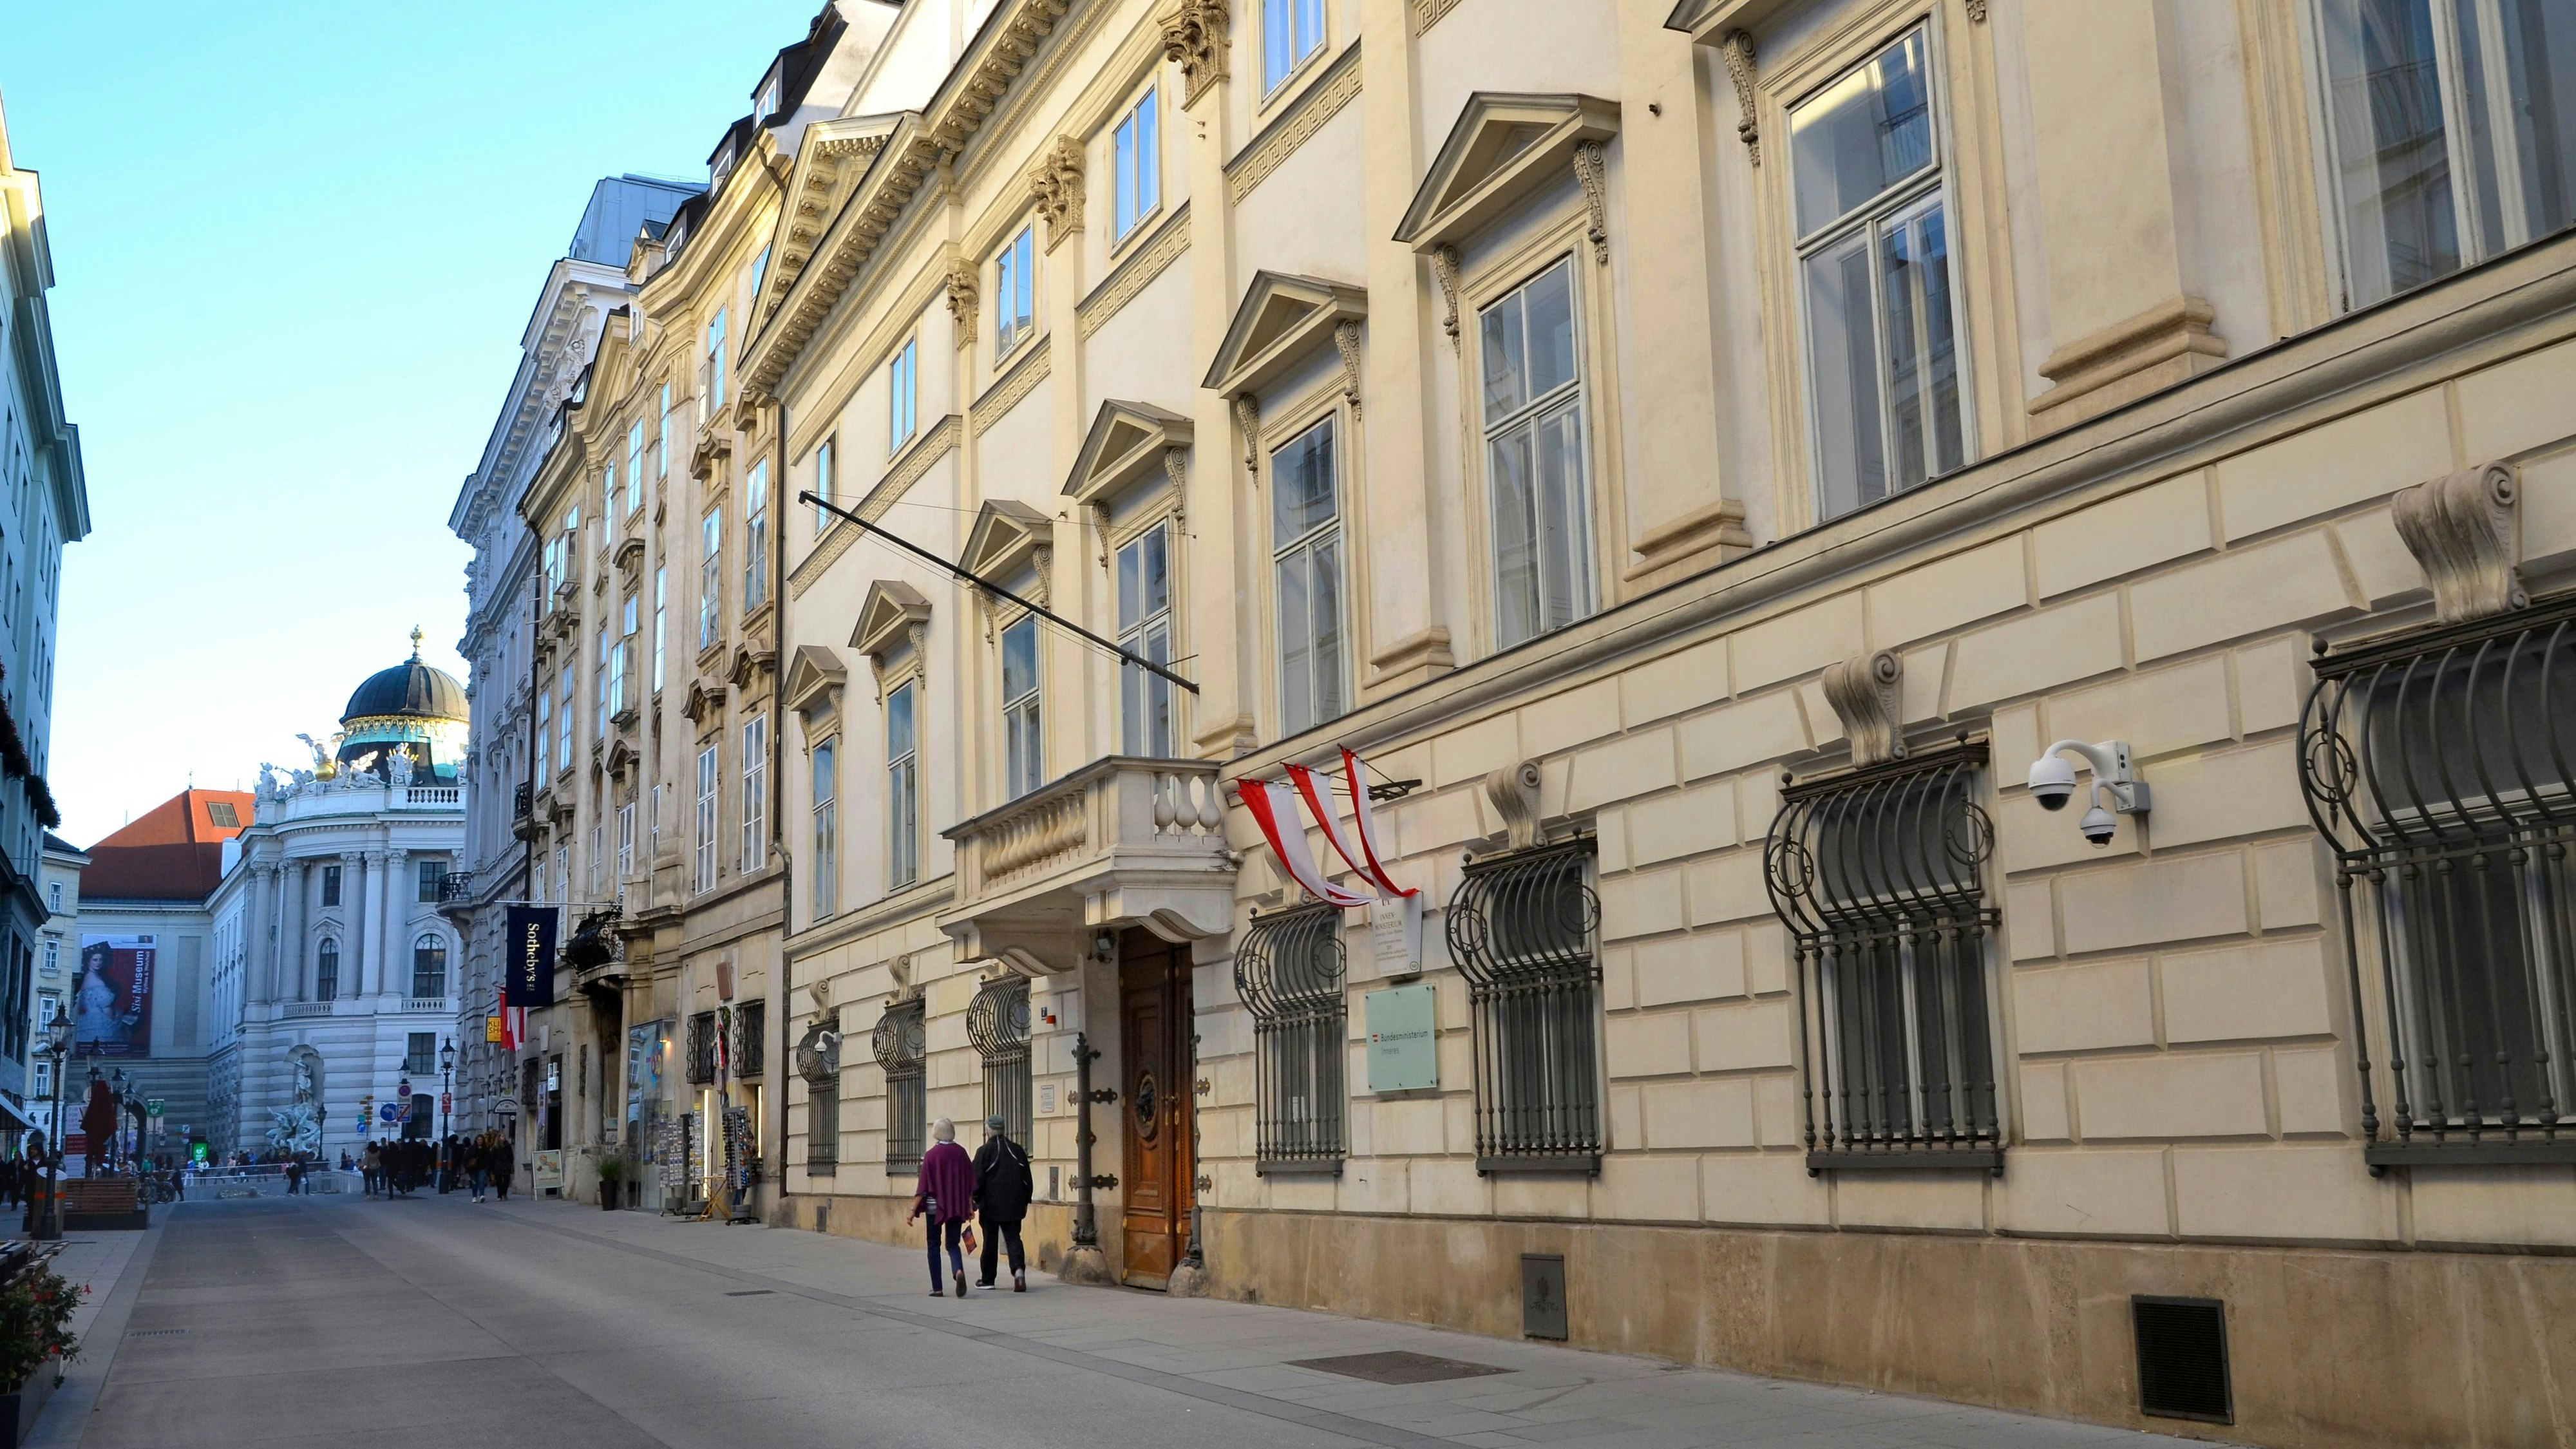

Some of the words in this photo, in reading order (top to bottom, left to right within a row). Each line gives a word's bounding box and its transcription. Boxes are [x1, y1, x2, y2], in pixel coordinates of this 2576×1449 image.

[524, 923, 540, 982] Sotheby's
[132, 951, 144, 994] Museum
[131, 996, 141, 1013] Sisi
[1381, 1030, 1428, 1042] Bundesministerium
